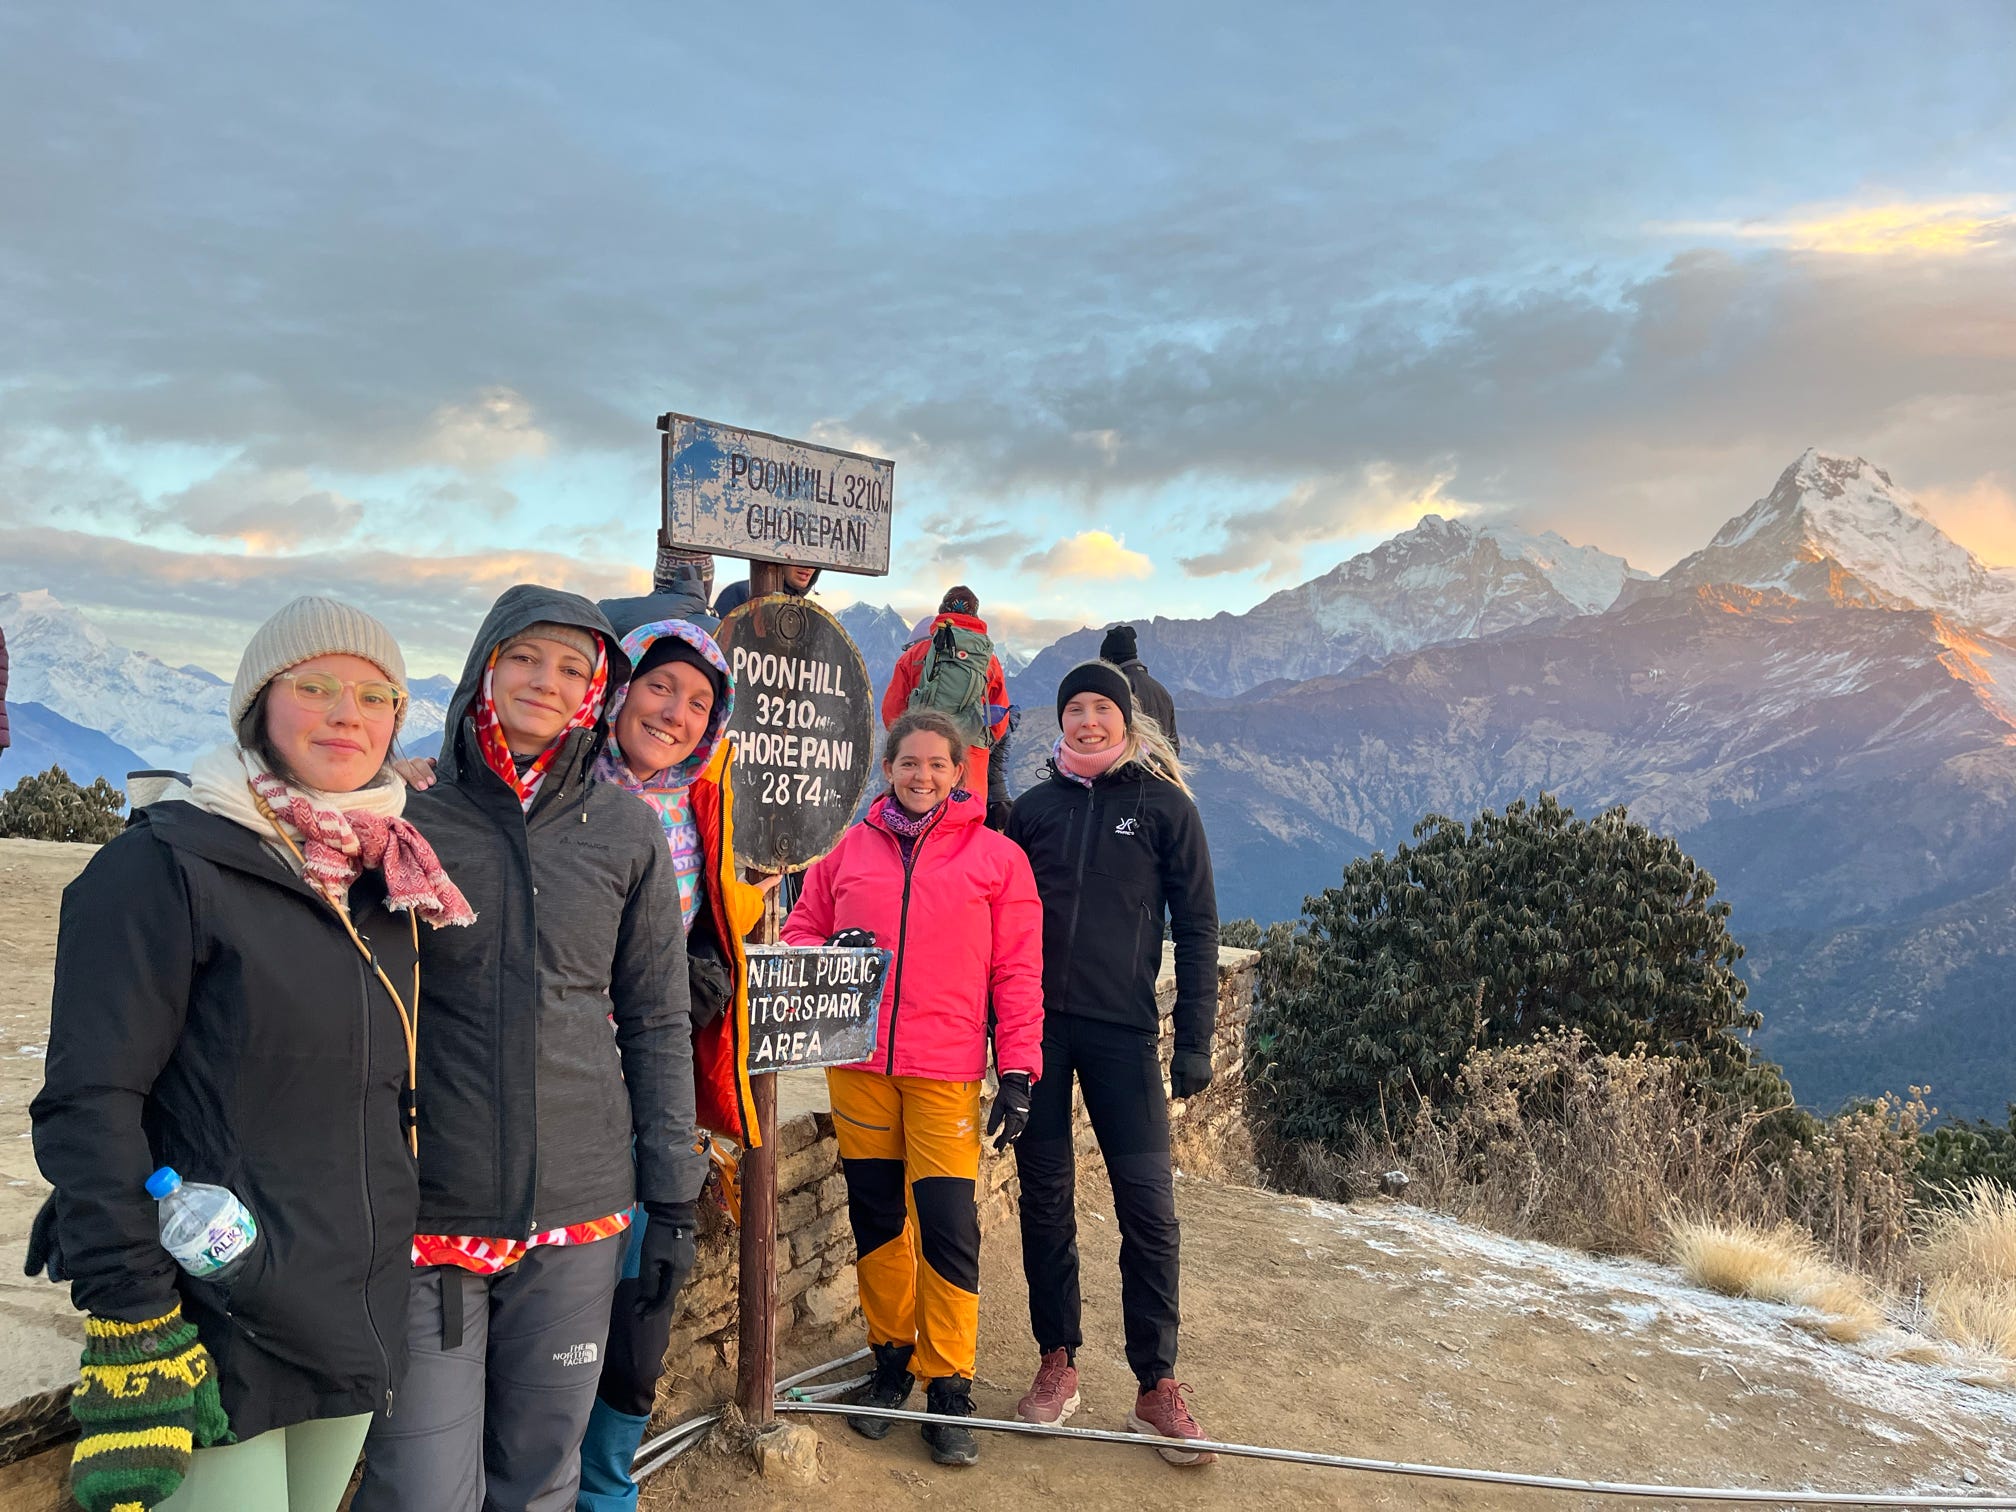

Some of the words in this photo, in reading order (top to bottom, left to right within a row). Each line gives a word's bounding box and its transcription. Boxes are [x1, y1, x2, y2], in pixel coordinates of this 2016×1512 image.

[731, 453, 839, 507] POONHILL
[746, 503, 867, 553] GHOREPANI
[748, 958, 809, 988] NHILL
[815, 956, 880, 987] PUBLIC
[754, 1030, 822, 1063] AREA
[552, 1351, 585, 1361] NORTH
[563, 1358, 584, 1367] FACE
[570, 1344, 586, 1353] THE
